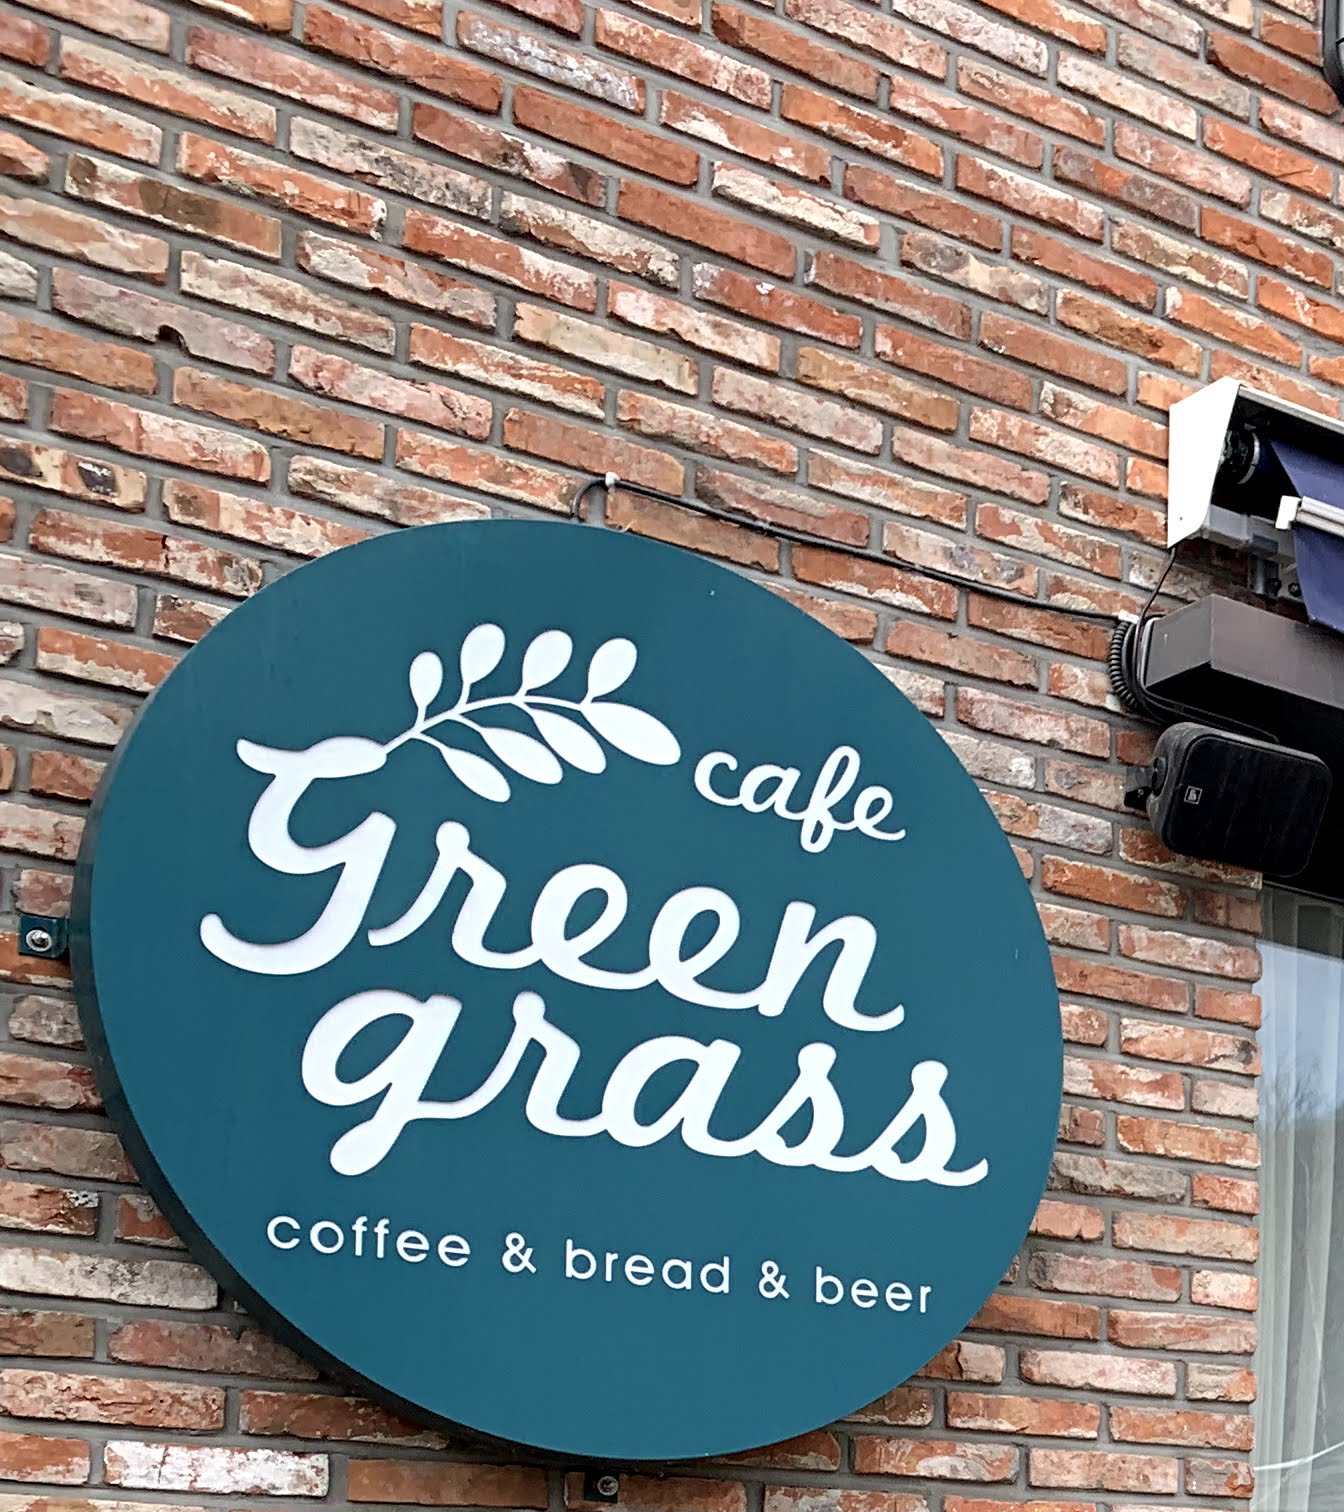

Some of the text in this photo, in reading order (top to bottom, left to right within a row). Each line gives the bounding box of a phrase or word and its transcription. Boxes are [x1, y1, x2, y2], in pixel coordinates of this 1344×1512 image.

[693, 744, 907, 854] cafe
[200, 735, 906, 1032] Green
[300, 989, 990, 1187] grass
[266, 1215, 932, 1314] coffee & bread & beer
